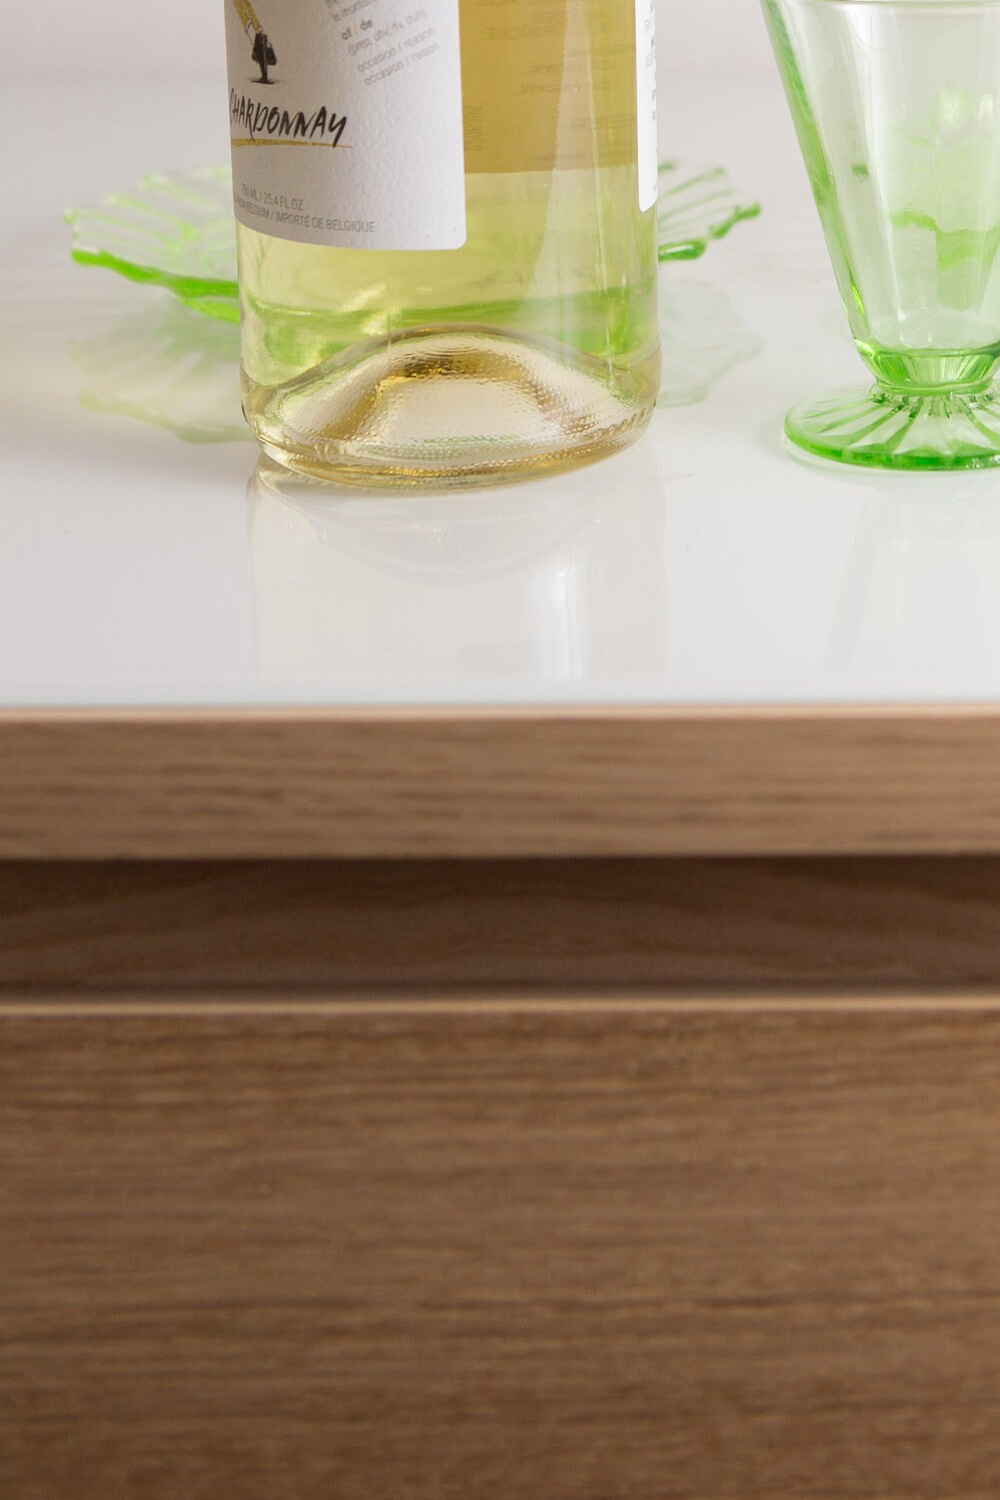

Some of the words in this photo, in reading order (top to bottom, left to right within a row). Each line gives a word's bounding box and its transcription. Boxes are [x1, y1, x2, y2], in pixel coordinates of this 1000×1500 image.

[341, 28, 352, 40] of
[360, 18, 373, 31] de
[230, 87, 348, 148] CHARDONNAY
[312, 216, 324, 230] DE
[326, 218, 376, 233] BELGIQUE
